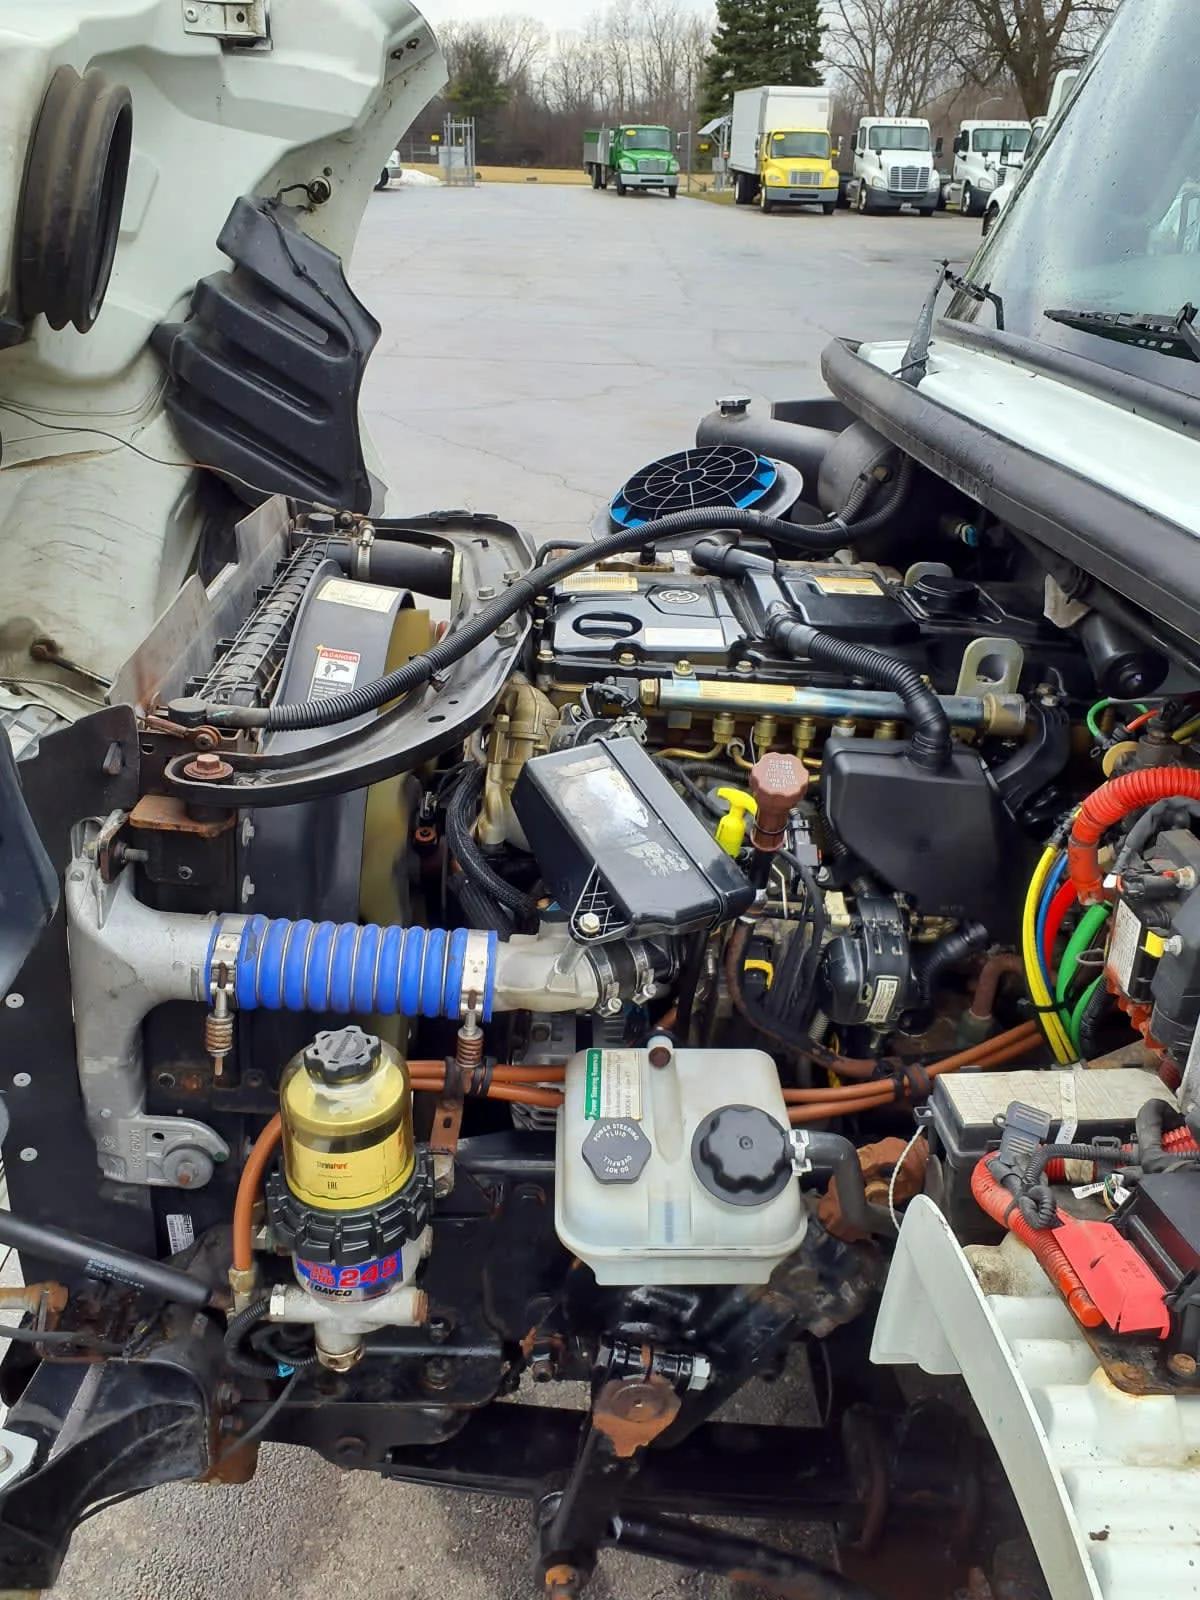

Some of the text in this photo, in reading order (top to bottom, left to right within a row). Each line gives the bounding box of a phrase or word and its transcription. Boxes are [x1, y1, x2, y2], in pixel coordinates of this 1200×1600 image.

[328, 652, 358, 662] DANGER
[593, 1123, 640, 1142] POWER STEERING
[606, 1130, 627, 1138] FLUID
[603, 1154, 633, 1167] OVERFILL
[604, 1166, 619, 1174] NOT
[339, 1254, 398, 1288] 245
[314, 1285, 353, 1297] DAVCO
